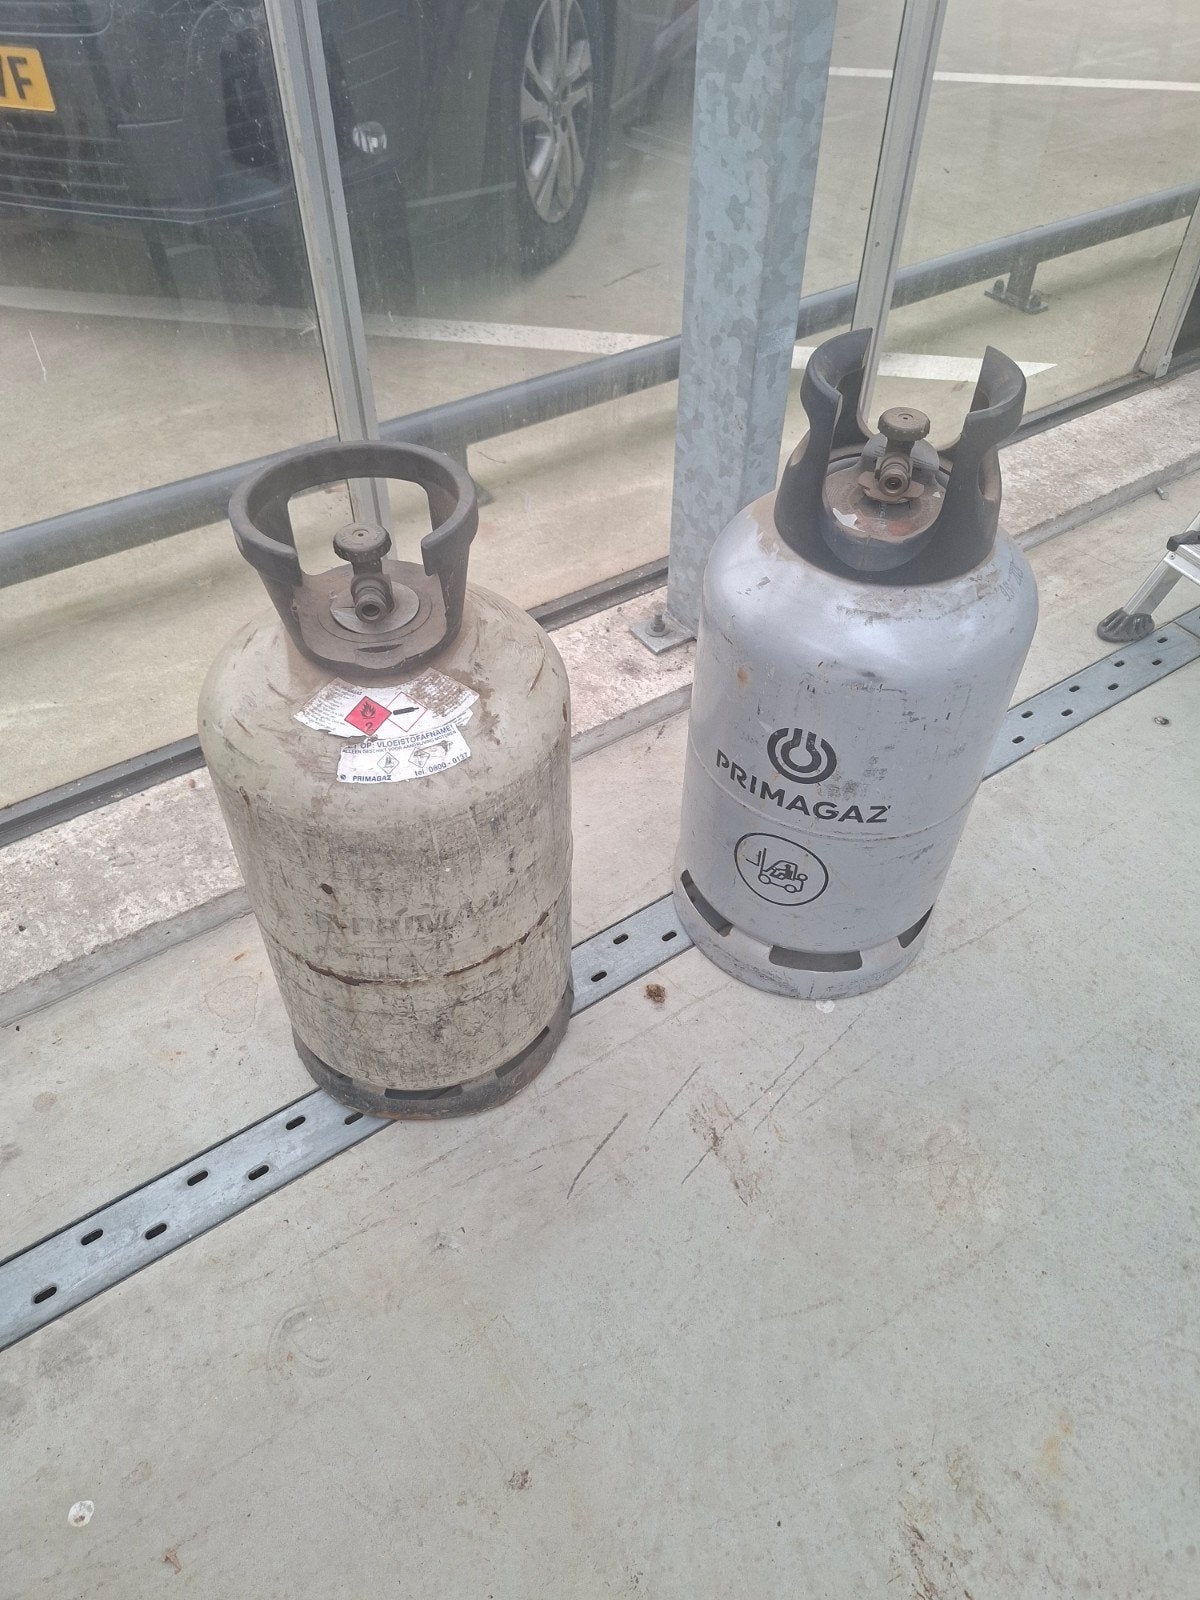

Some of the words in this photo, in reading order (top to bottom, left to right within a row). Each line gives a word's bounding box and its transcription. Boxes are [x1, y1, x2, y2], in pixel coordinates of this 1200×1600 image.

[0, 54, 32, 100] F
[352, 774, 392, 782] PRIMAGAZ
[716, 749, 889, 823] PRIMAGAZ
